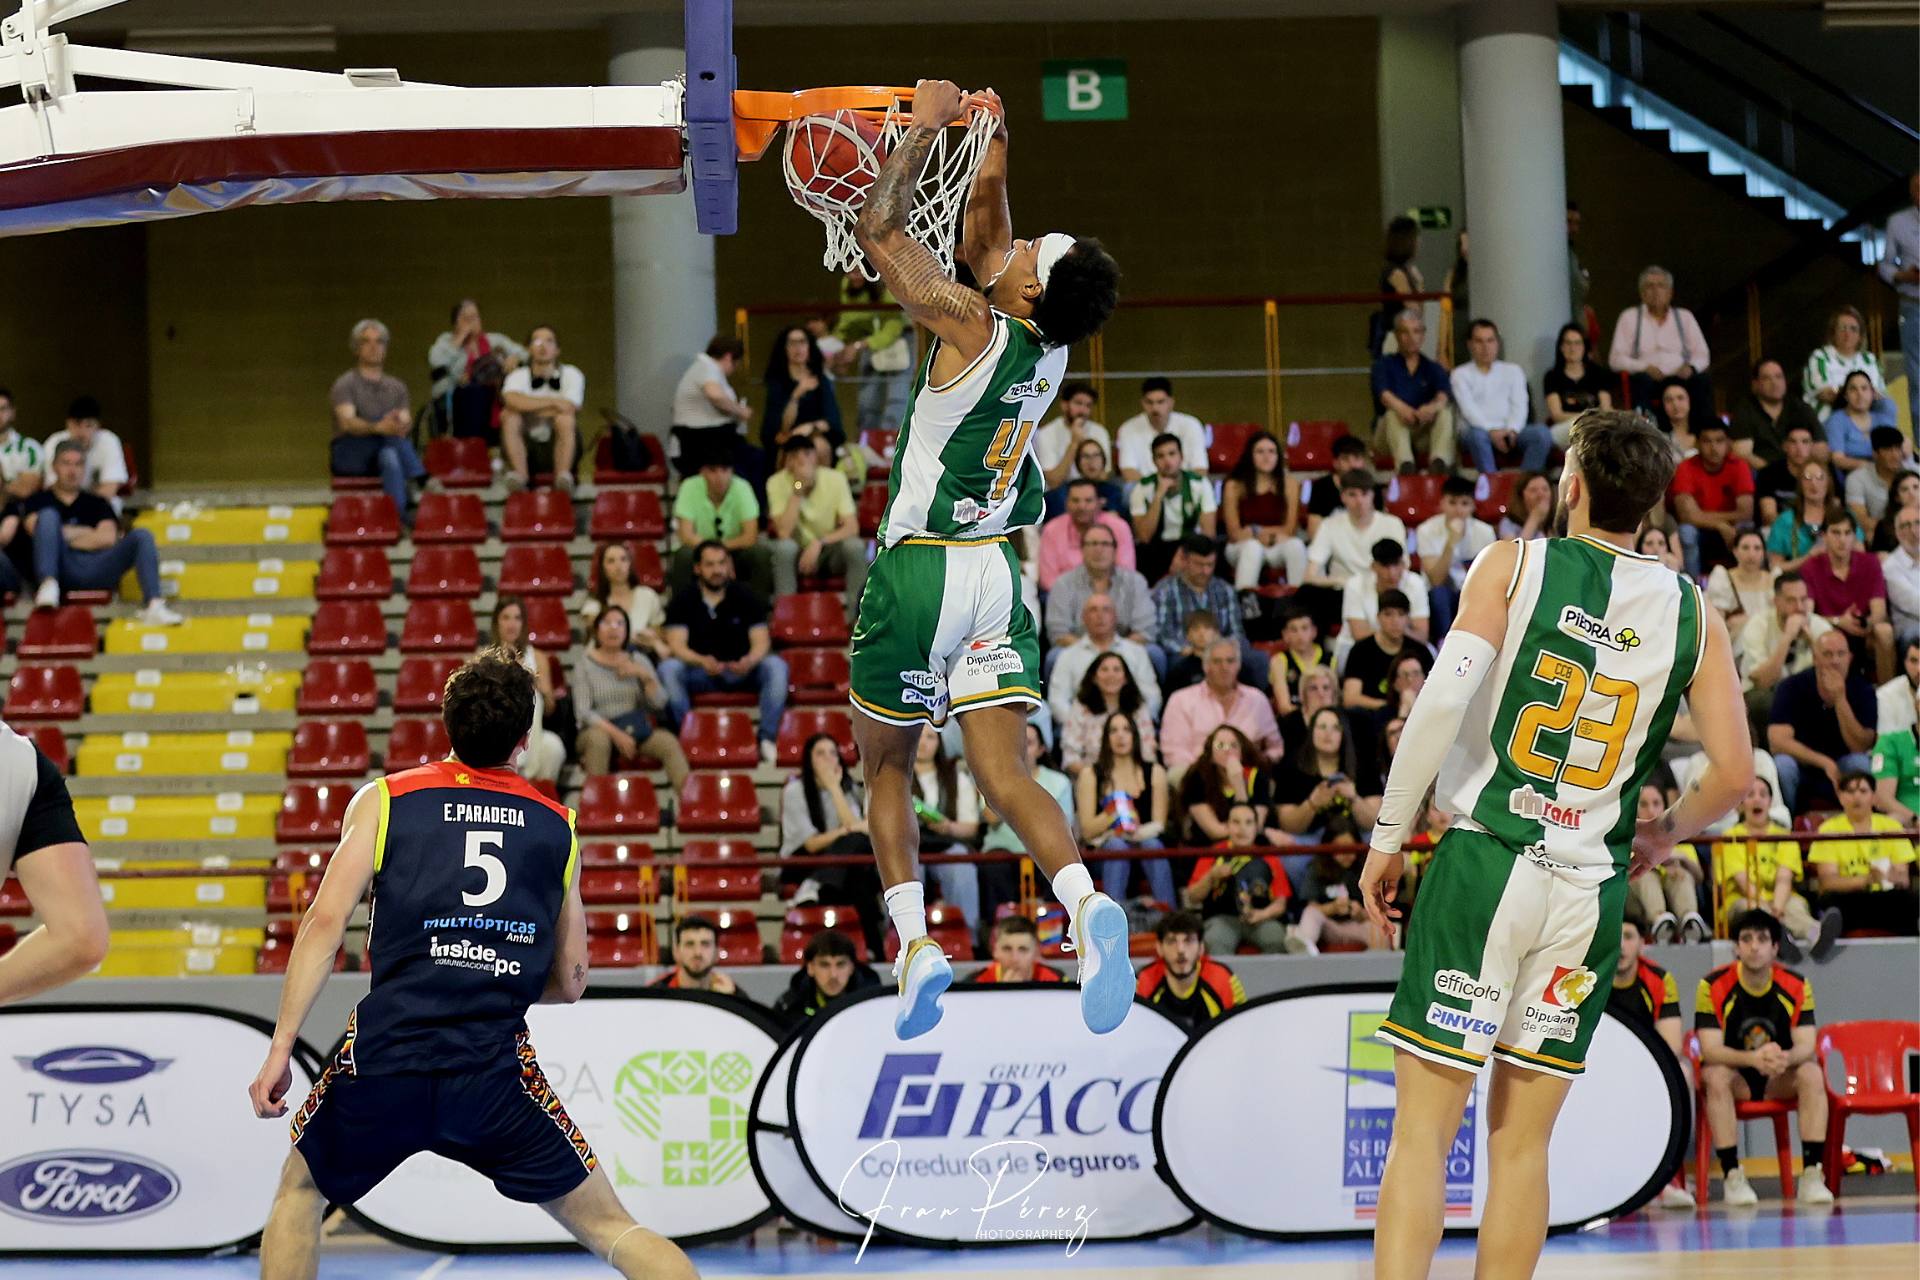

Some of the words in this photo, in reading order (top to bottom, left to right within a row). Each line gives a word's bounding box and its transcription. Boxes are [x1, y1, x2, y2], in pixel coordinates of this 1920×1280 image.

[1067, 69, 1103, 111] B
[985, 419, 1034, 500] 4
[966, 650, 1019, 667] Diputación
[967, 667, 980, 677] de
[982, 662, 1021, 675] Córdoba
[1554, 662, 1574, 680] CCB
[1508, 649, 1640, 791] 23
[443, 803, 526, 828] E.PARADEDA
[461, 830, 508, 907] 5
[430, 936, 498, 962] inside
[1437, 974, 1501, 1002] efficold
[989, 1062, 1067, 1079] GRUPO
[27, 1092, 151, 1126] TYSA
[860, 1152, 992, 1179] Corredura
[997, 1151, 1029, 1175] de
[1036, 1151, 1141, 1178] Seguros
[20, 1159, 143, 1213] Ford
